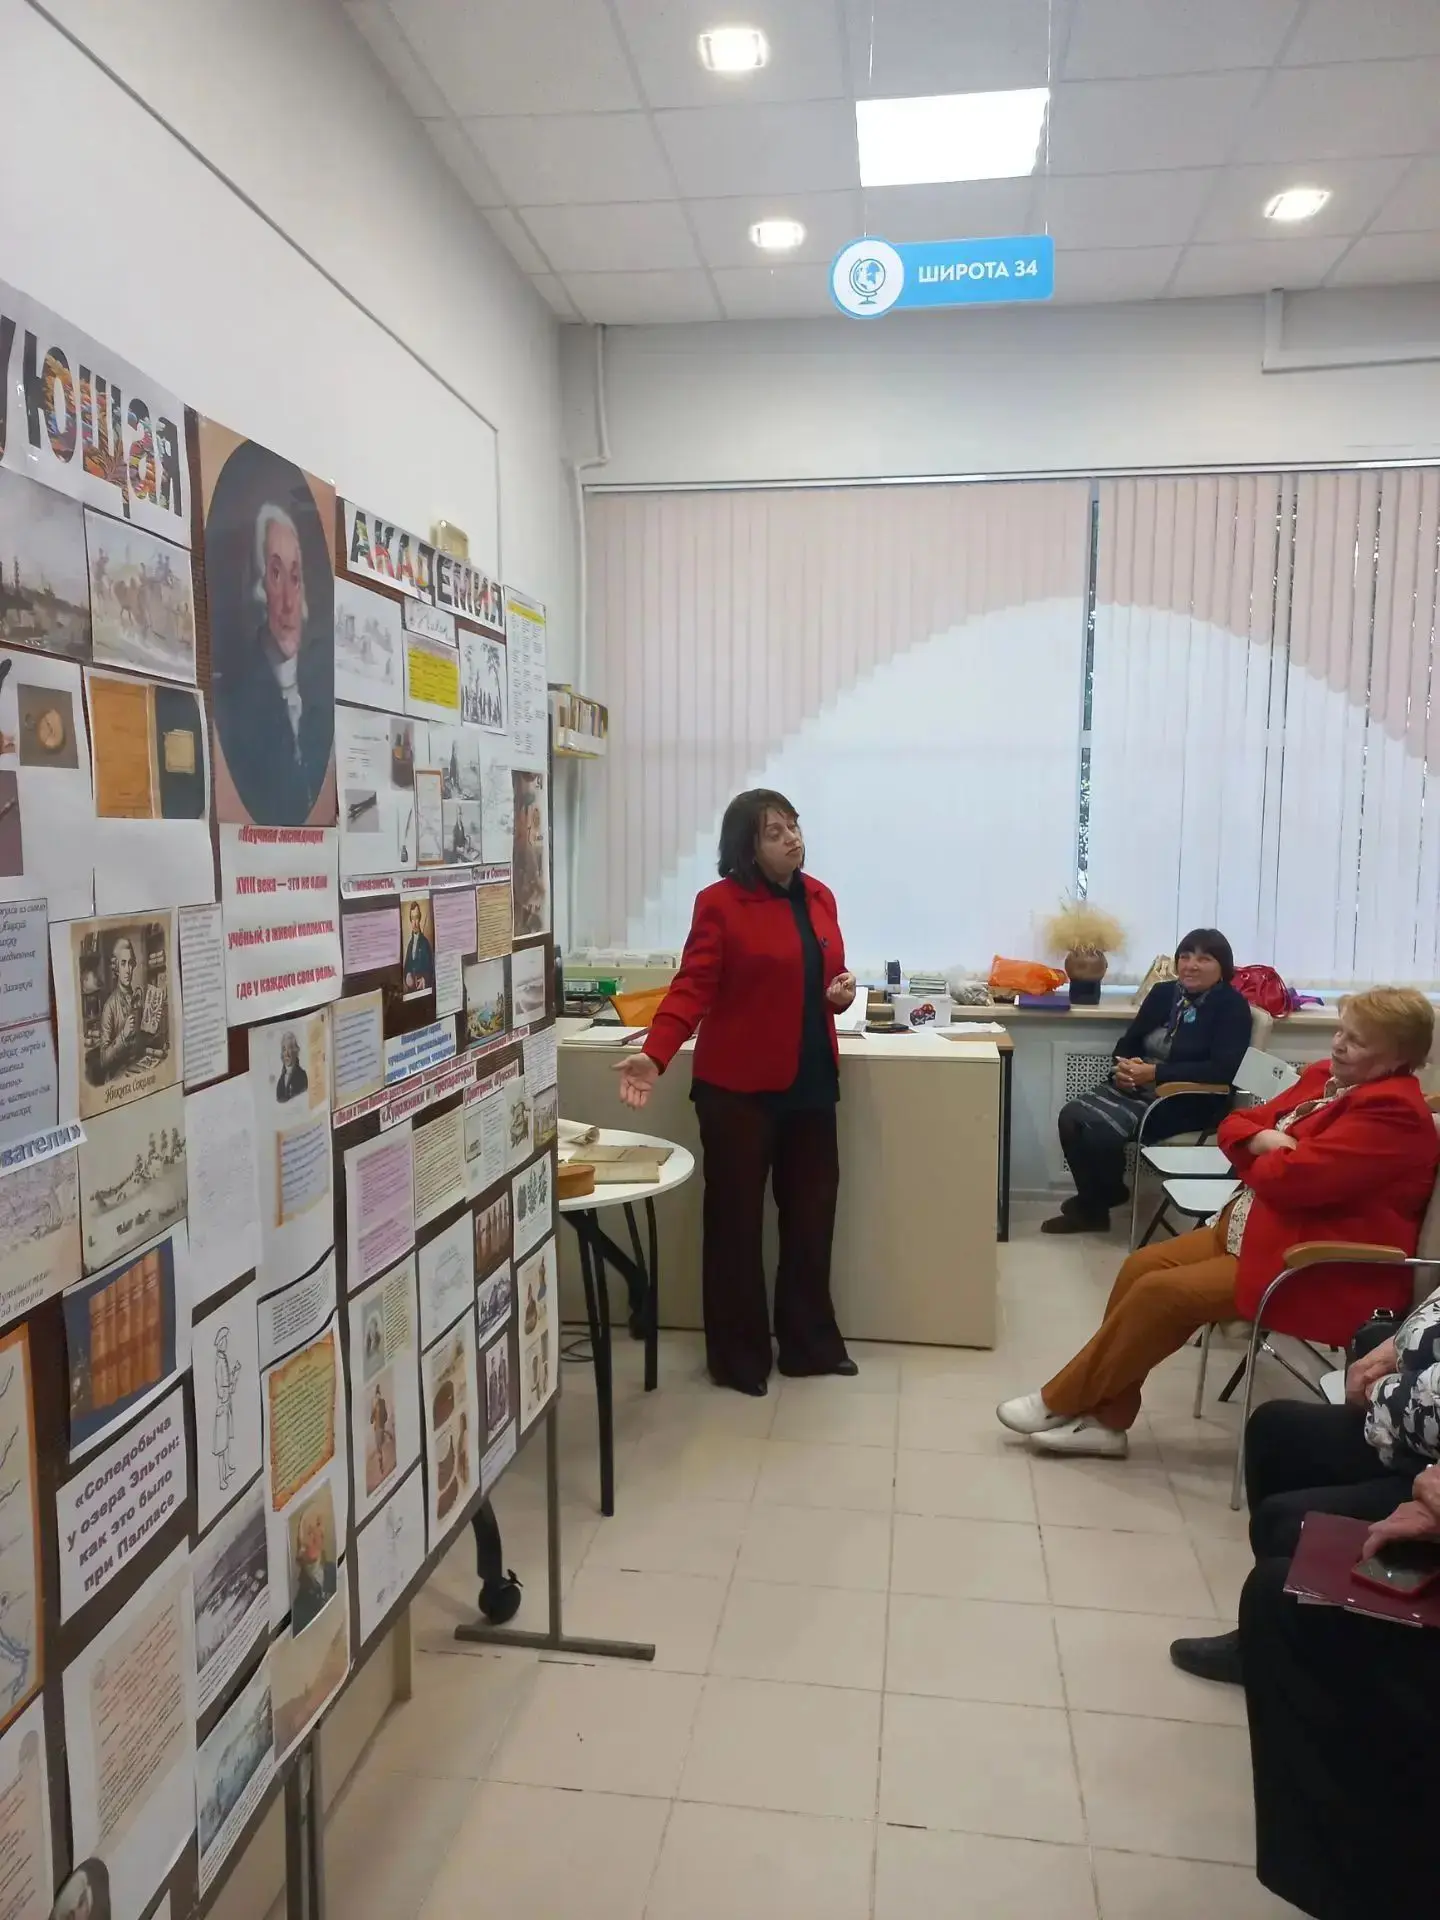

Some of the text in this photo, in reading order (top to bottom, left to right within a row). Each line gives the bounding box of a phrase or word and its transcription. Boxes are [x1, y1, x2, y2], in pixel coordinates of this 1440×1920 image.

[918, 259, 1038, 283] ШИРОТА 34
[350, 510, 503, 627] АКАДЕМИЯ
[236, 981, 252, 1000] где
[253, 980, 259, 996] у
[260, 973, 296, 992] каждого
[296, 968, 315, 985] своя
[0, 1124, 81, 1168] ватели»
[67, 1436, 180, 1552] у озера Эльтон:
[75, 1416, 172, 1508] «Соледобыча
[79, 1470, 172, 1567] как это было
[84, 1557, 113, 1592] при
[117, 1493, 175, 1559] Палласе
